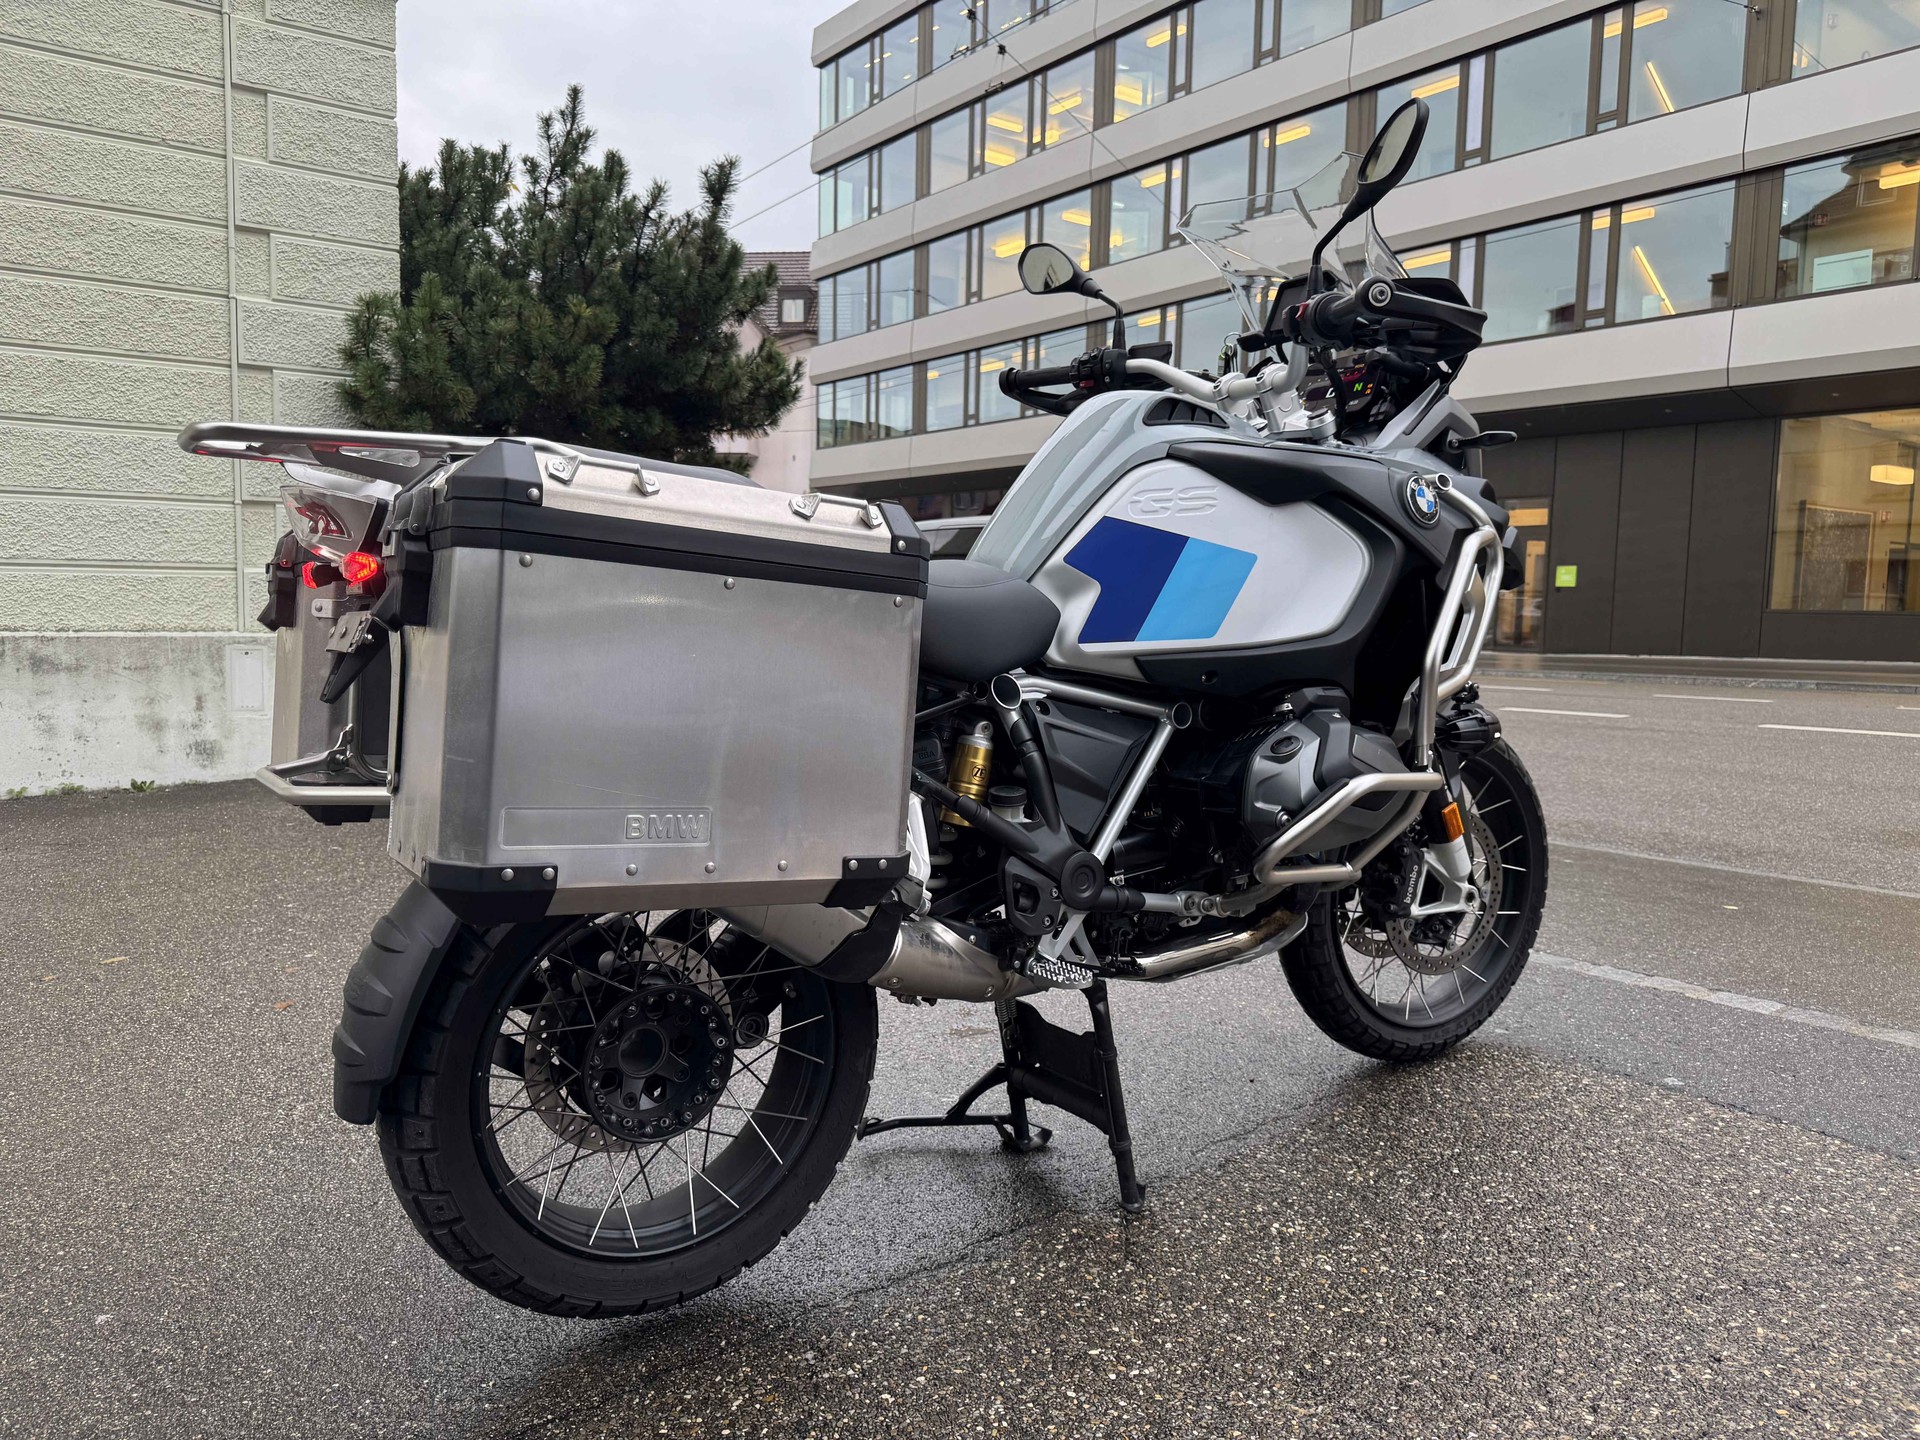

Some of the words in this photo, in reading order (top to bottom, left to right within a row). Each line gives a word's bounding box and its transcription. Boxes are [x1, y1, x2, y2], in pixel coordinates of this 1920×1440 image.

[1353, 382, 1364, 392] N
[1127, 486, 1219, 519] GS
[625, 814, 705, 840] BMW
[1403, 864, 1419, 904] brembo
